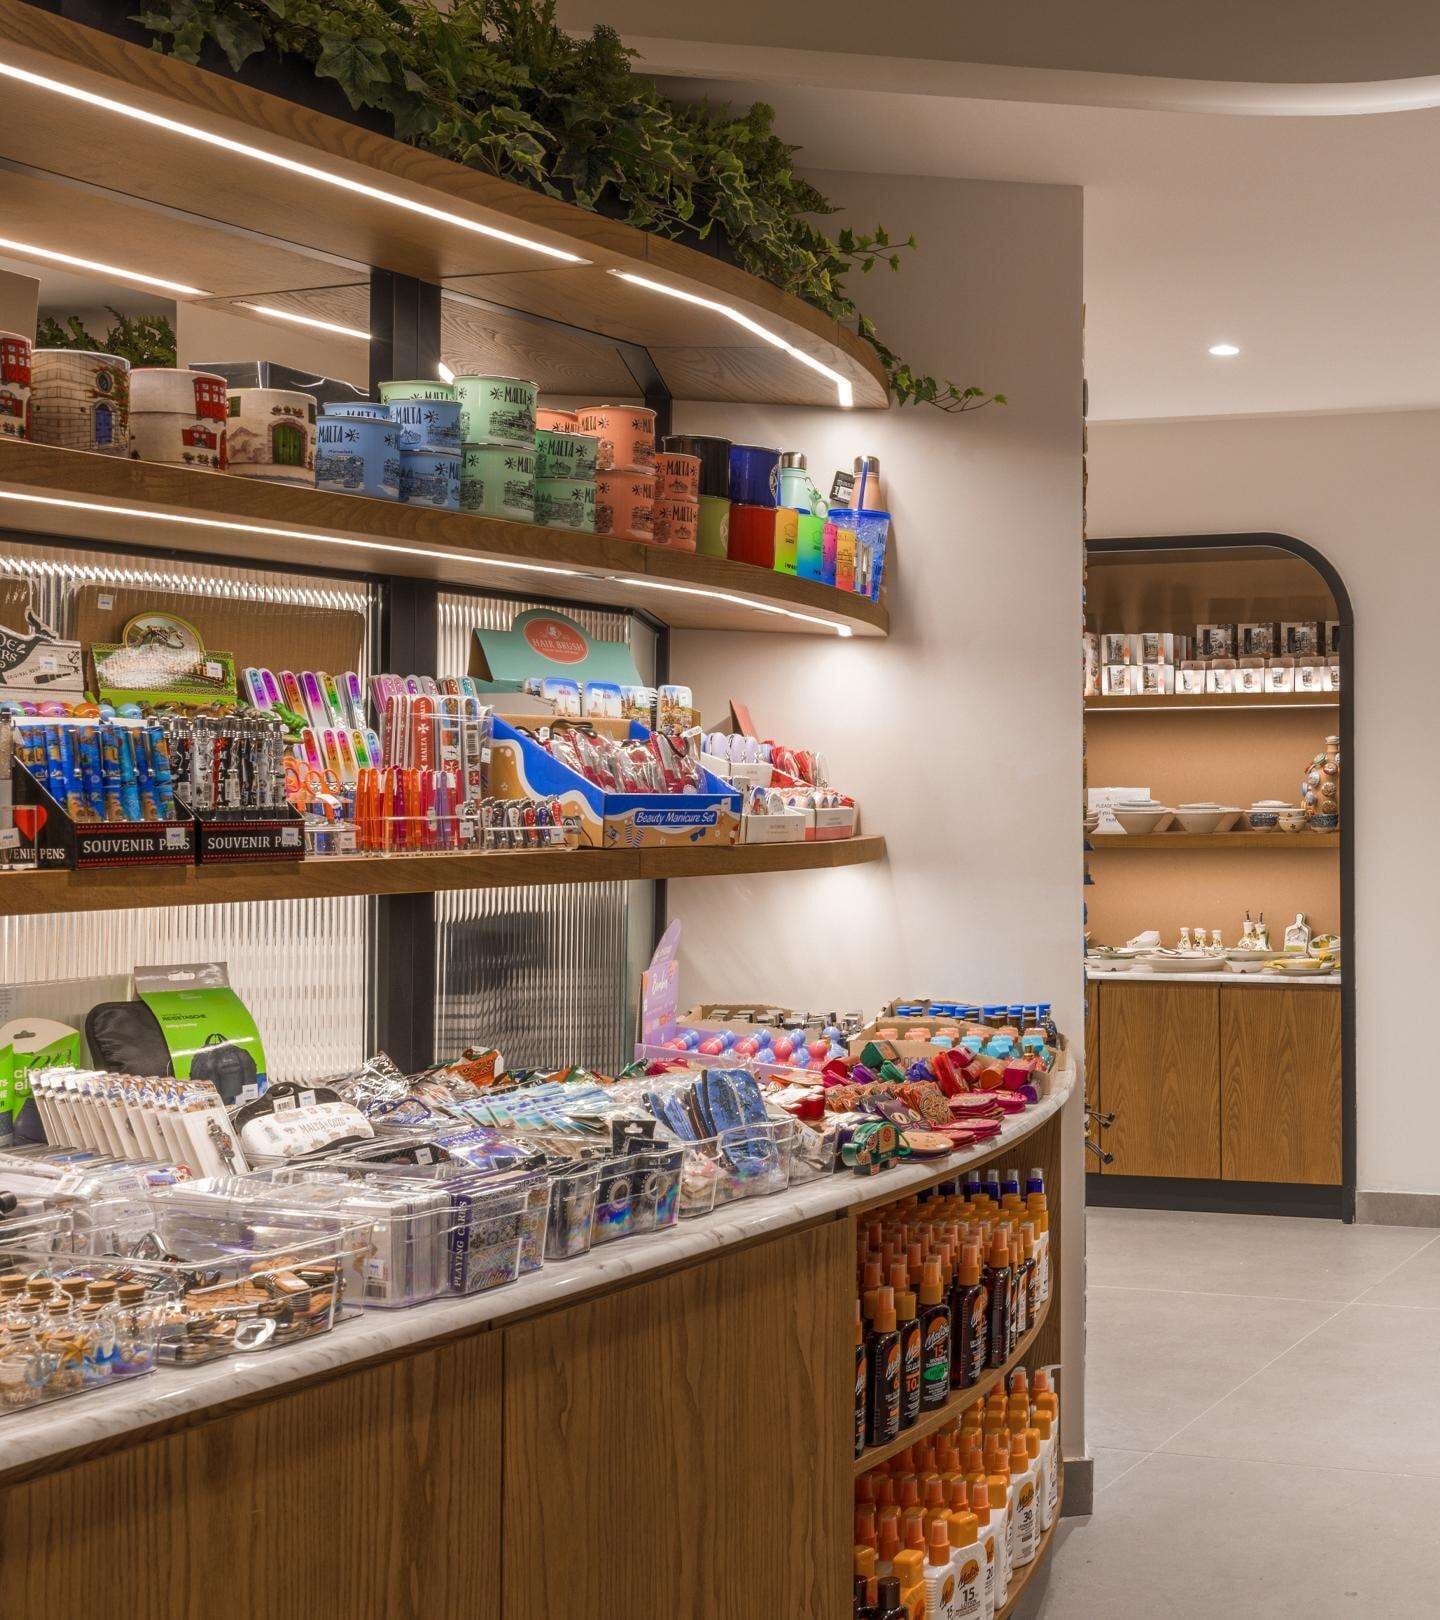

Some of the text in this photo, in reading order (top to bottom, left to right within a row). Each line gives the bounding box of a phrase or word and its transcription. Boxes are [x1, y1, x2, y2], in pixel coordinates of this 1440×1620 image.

[504, 386, 528, 405] MALTA
[395, 406, 422, 425] MALTA
[318, 425, 343, 444] MALTA
[547, 440, 574, 458] MALTA
[666, 460, 690, 477] MALTA
[672, 505, 693, 522] MALTA
[532, 637, 584, 652] HAIR BRUSH
[420, 736, 428, 761] MALTA
[636, 810, 715, 825] Beauty Manicure Set
[83, 839, 154, 854] SOUVENIR
[207, 836, 271, 851] SOUVENIR
[39, 848, 65, 860] PENS
[453, 1200, 468, 1288] PLAYING CARDS
[1023, 1508, 1033, 1523] 30
[962, 1586, 975, 1603] 15
